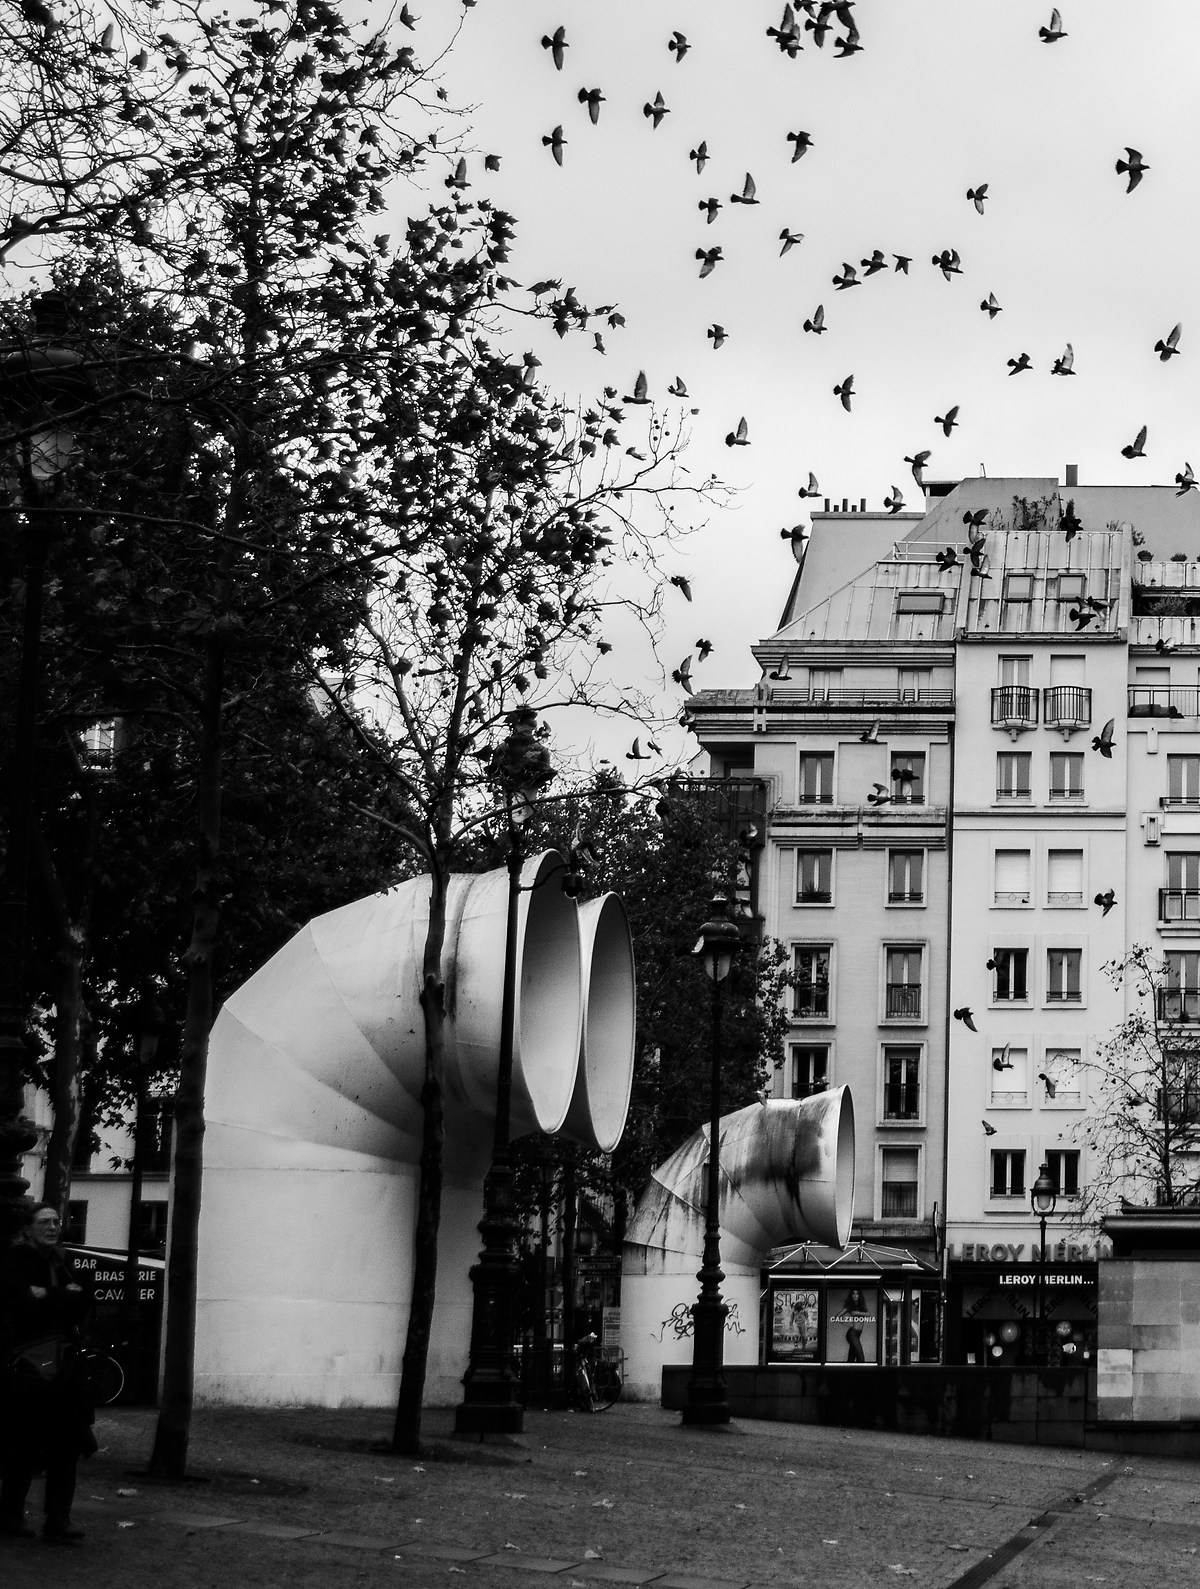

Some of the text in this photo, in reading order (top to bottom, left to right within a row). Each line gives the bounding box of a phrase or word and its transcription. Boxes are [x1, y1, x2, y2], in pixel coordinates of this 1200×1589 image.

[948, 1243, 1113, 1262] LEROY MERLIN
[74, 1258, 97, 1270] BAR
[94, 1270, 156, 1282] BRASRIE
[999, 1274, 1036, 1285] LEROY
[94, 1288, 155, 1300] CAVER
